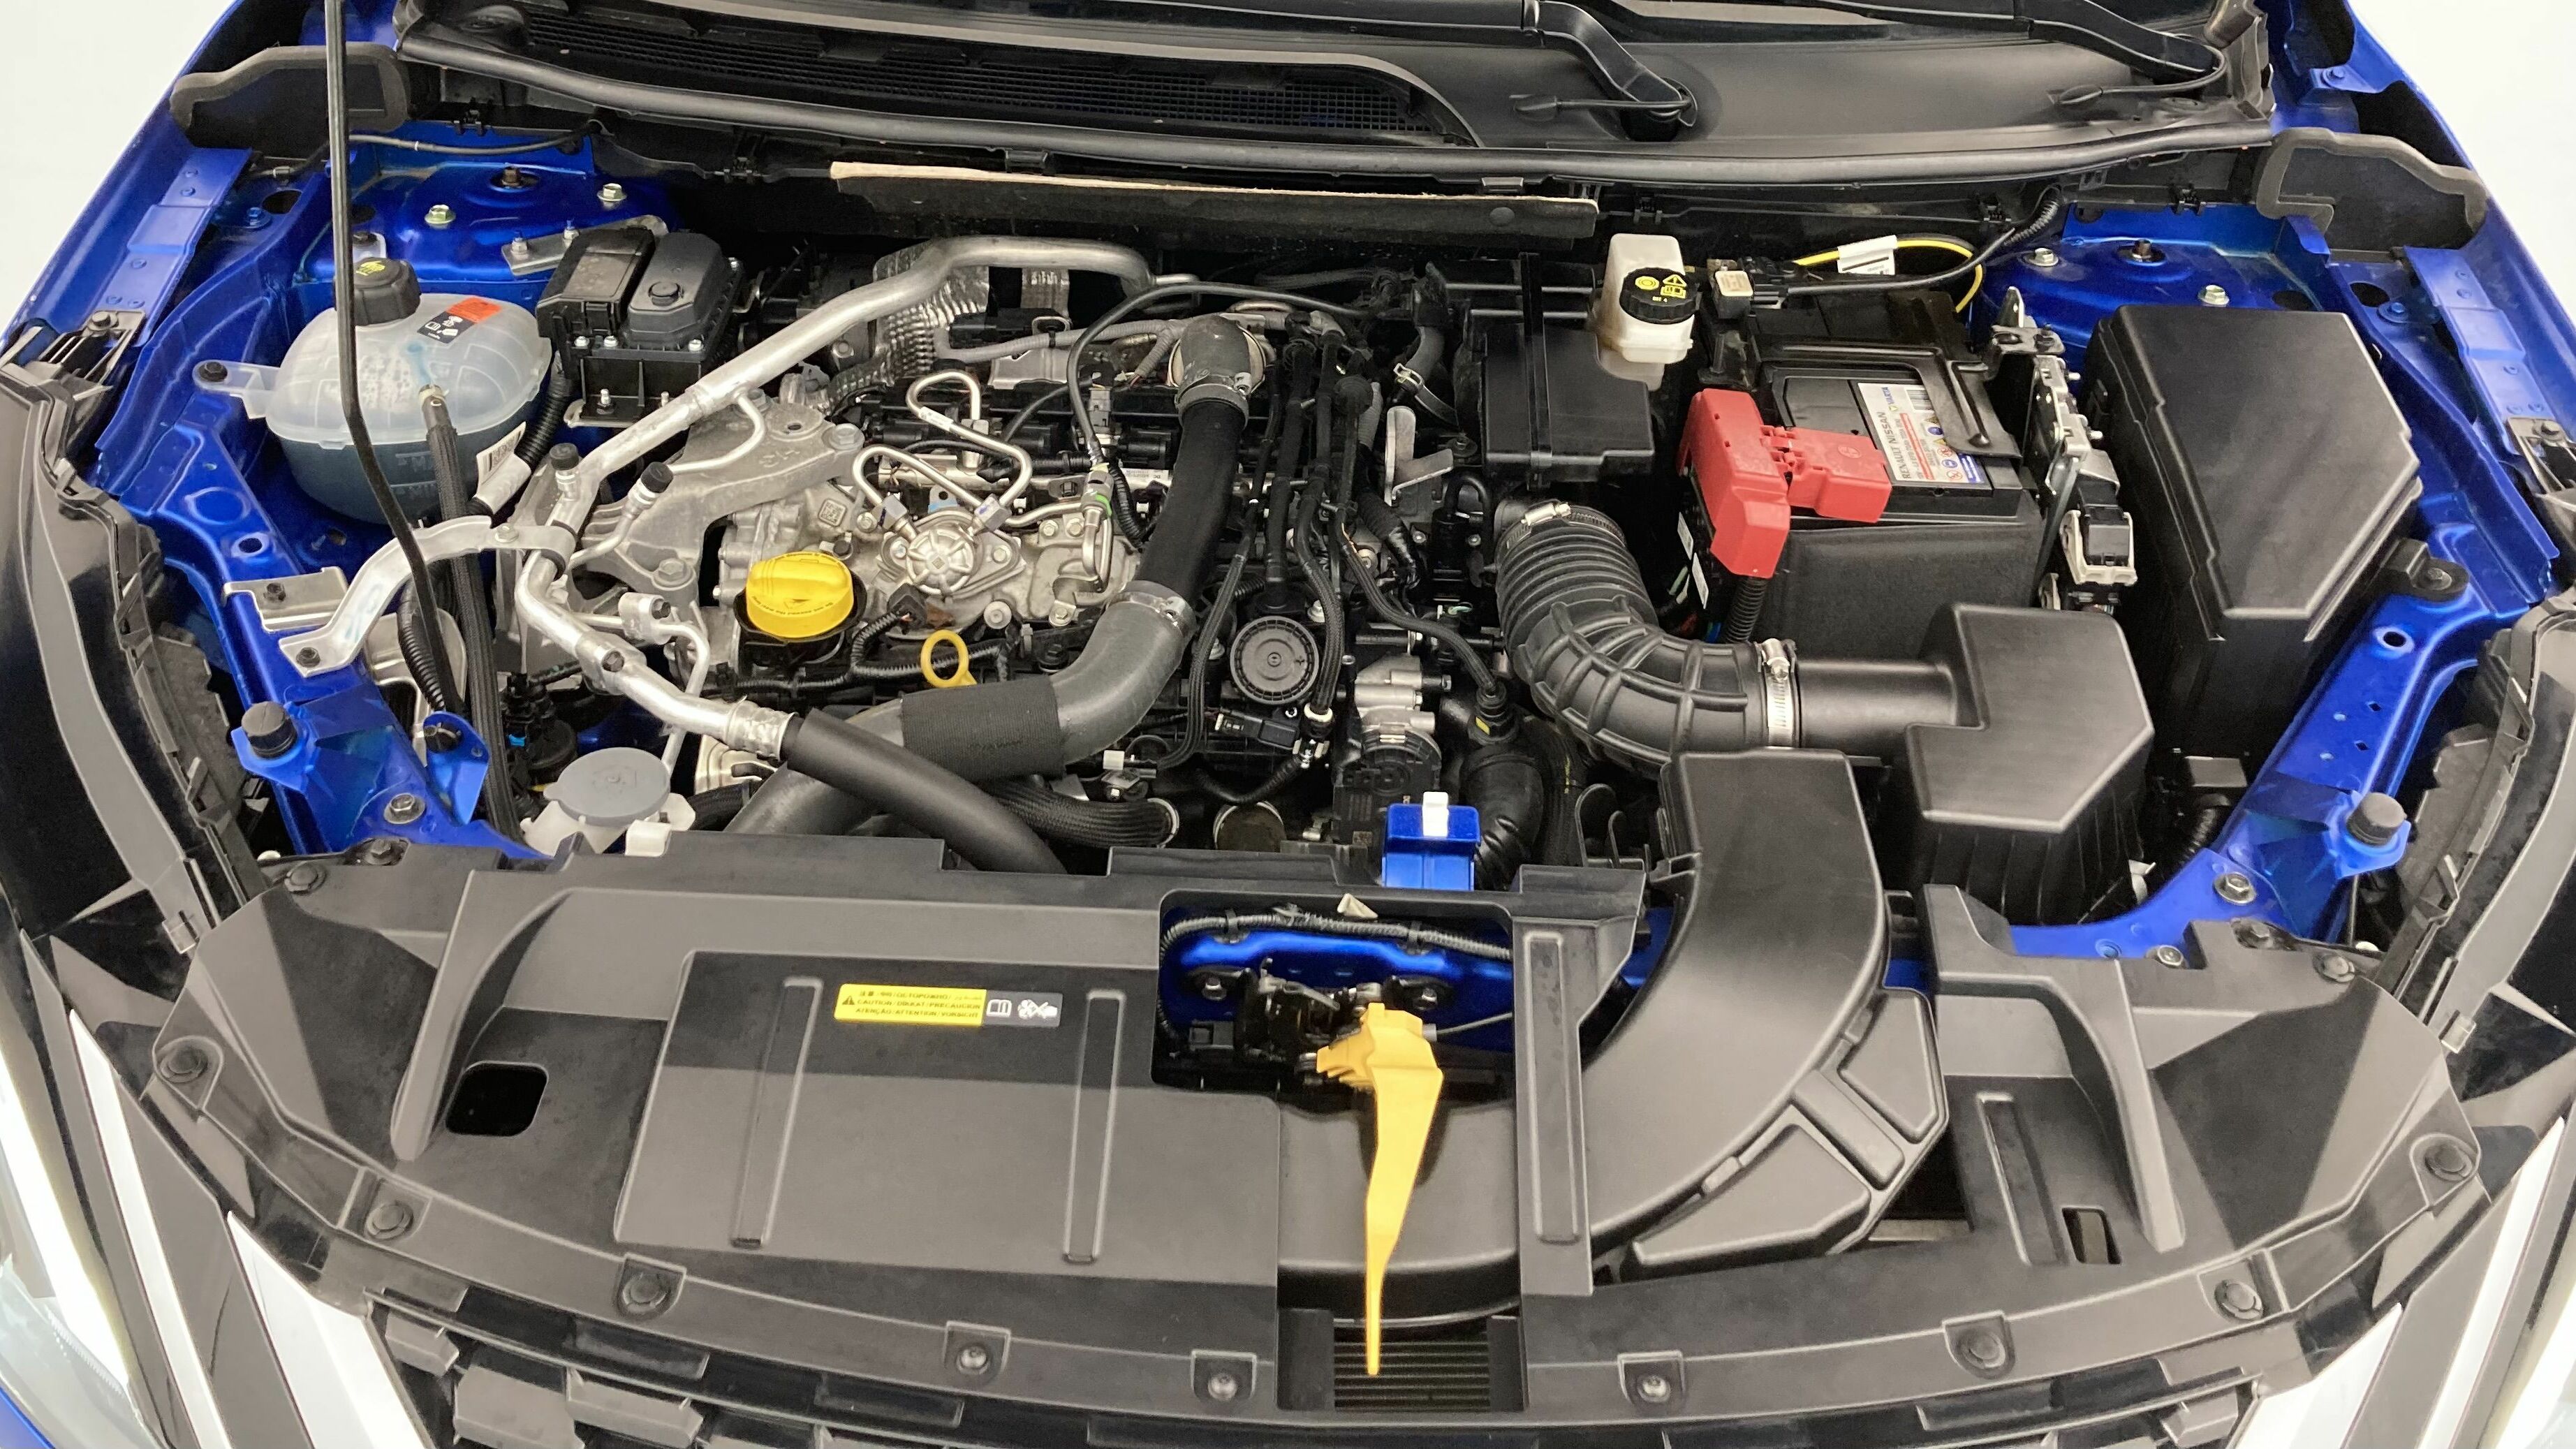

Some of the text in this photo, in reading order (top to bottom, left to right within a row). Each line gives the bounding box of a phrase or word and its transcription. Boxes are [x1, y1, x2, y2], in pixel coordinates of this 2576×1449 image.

[1881, 387, 1894, 404] VARTA
[1876, 411, 1911, 479] RENAULT NISSAN
